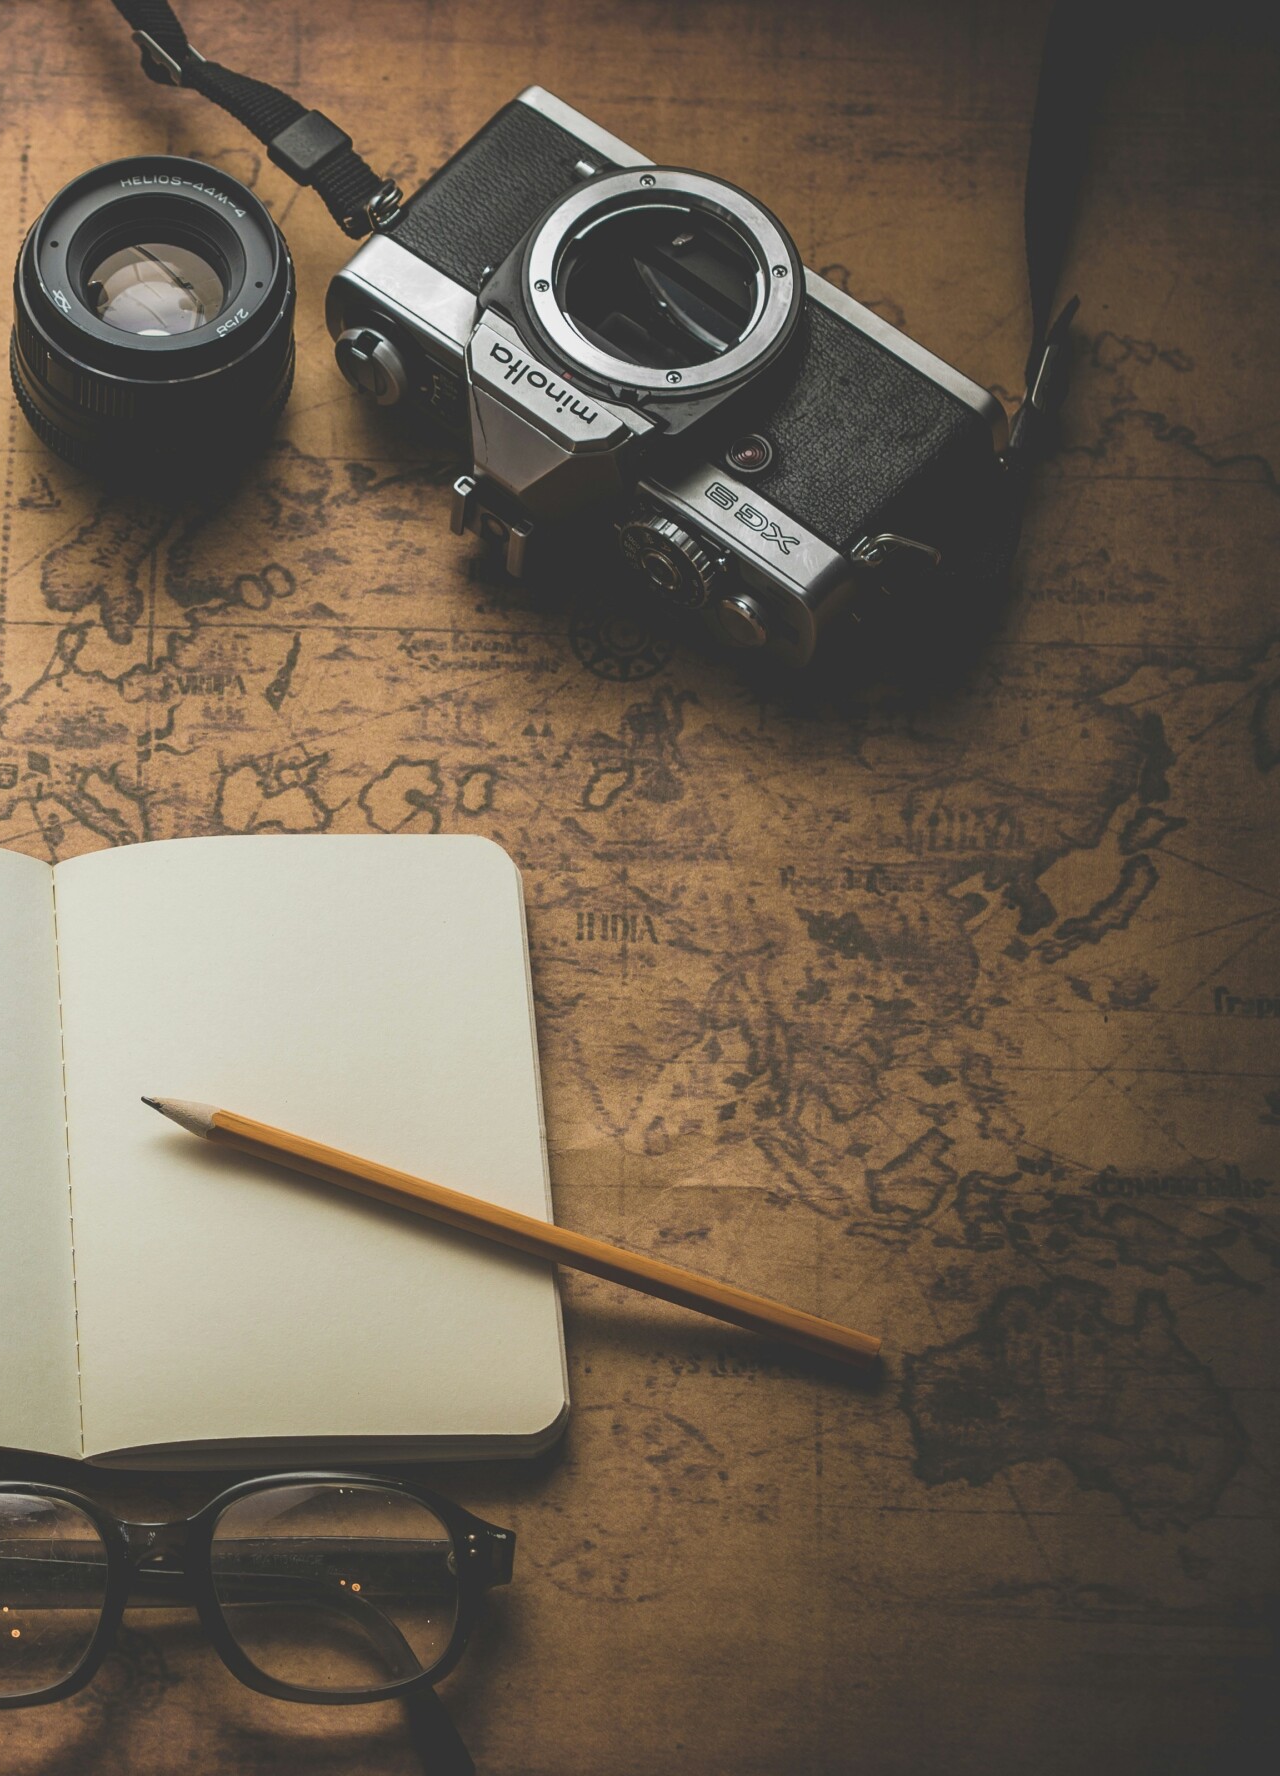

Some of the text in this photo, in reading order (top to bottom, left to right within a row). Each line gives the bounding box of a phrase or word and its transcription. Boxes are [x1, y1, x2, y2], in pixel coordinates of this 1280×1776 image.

[120, 174, 247, 218] HELIOS-44M-4
[216, 308, 249, 338] 2/58
[489, 342, 599, 425] minolta
[734, 502, 800, 555] XG
